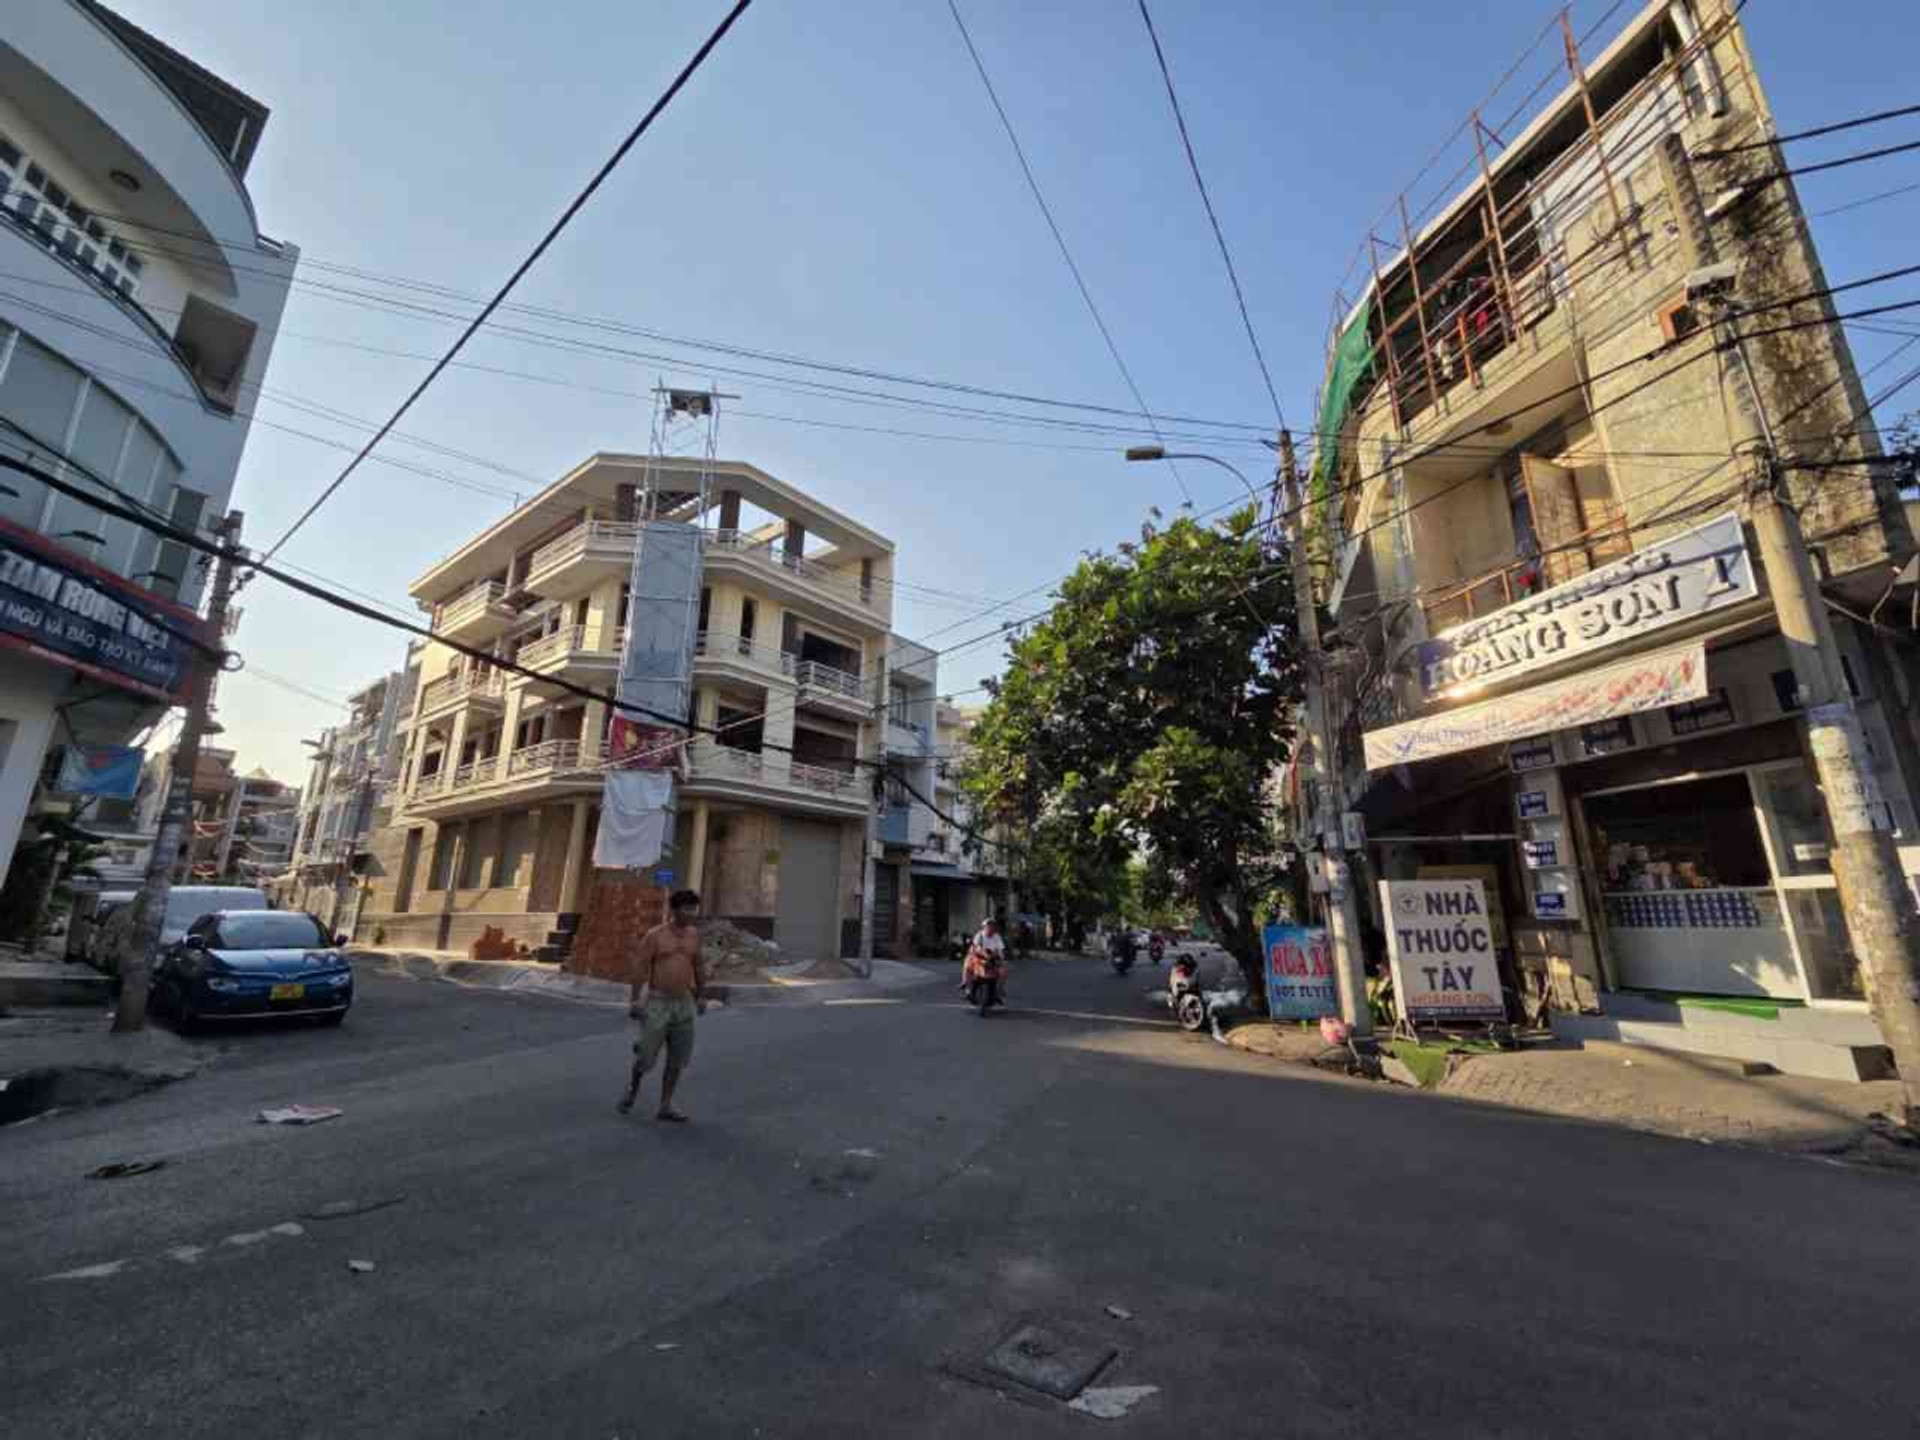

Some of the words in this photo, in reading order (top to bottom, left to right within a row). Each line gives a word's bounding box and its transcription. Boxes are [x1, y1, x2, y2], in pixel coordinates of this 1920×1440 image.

[1425, 884, 1481, 915] NHÀ
[1398, 918, 1488, 954] THUỐC
[1422, 961, 1474, 991] TÂY
